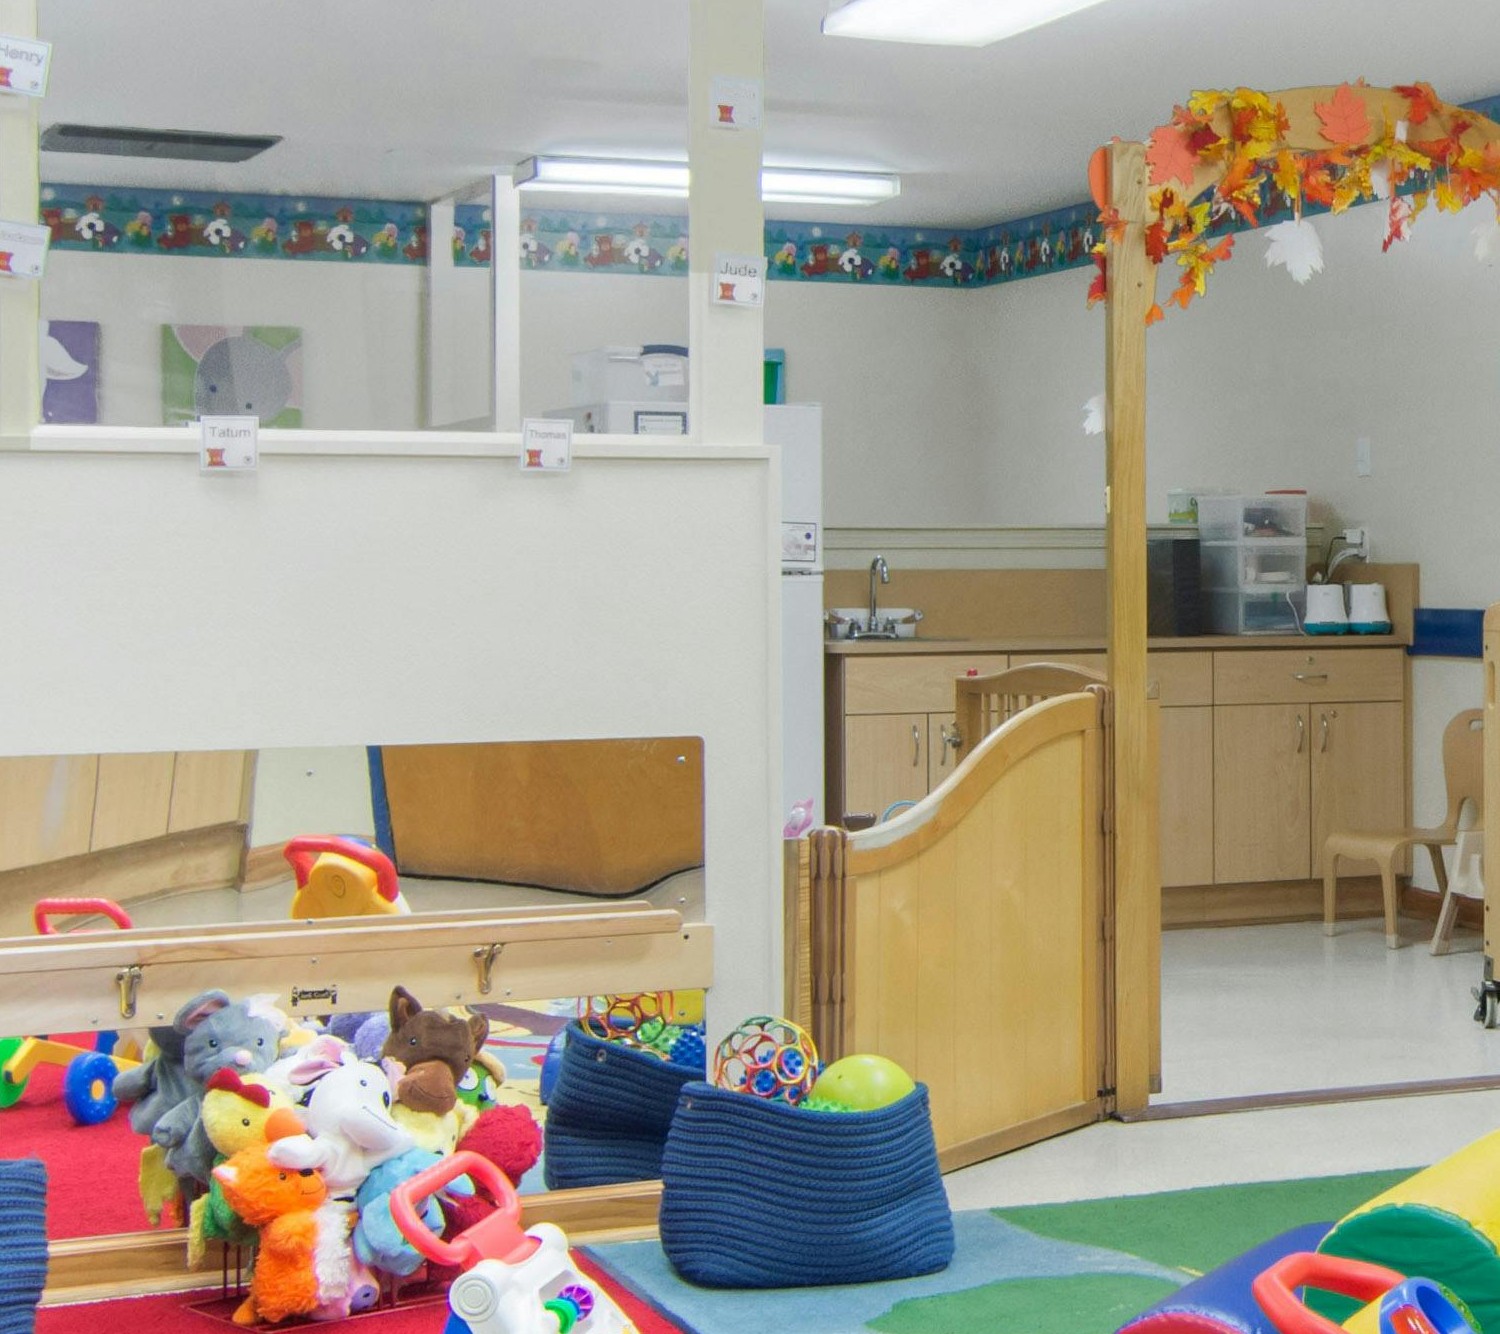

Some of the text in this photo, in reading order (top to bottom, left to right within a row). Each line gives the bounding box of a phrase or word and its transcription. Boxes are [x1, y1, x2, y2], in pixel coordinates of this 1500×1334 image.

[720, 262, 757, 278] Jude
[209, 427, 252, 438] Tatum
[530, 429, 567, 440] Thomas
